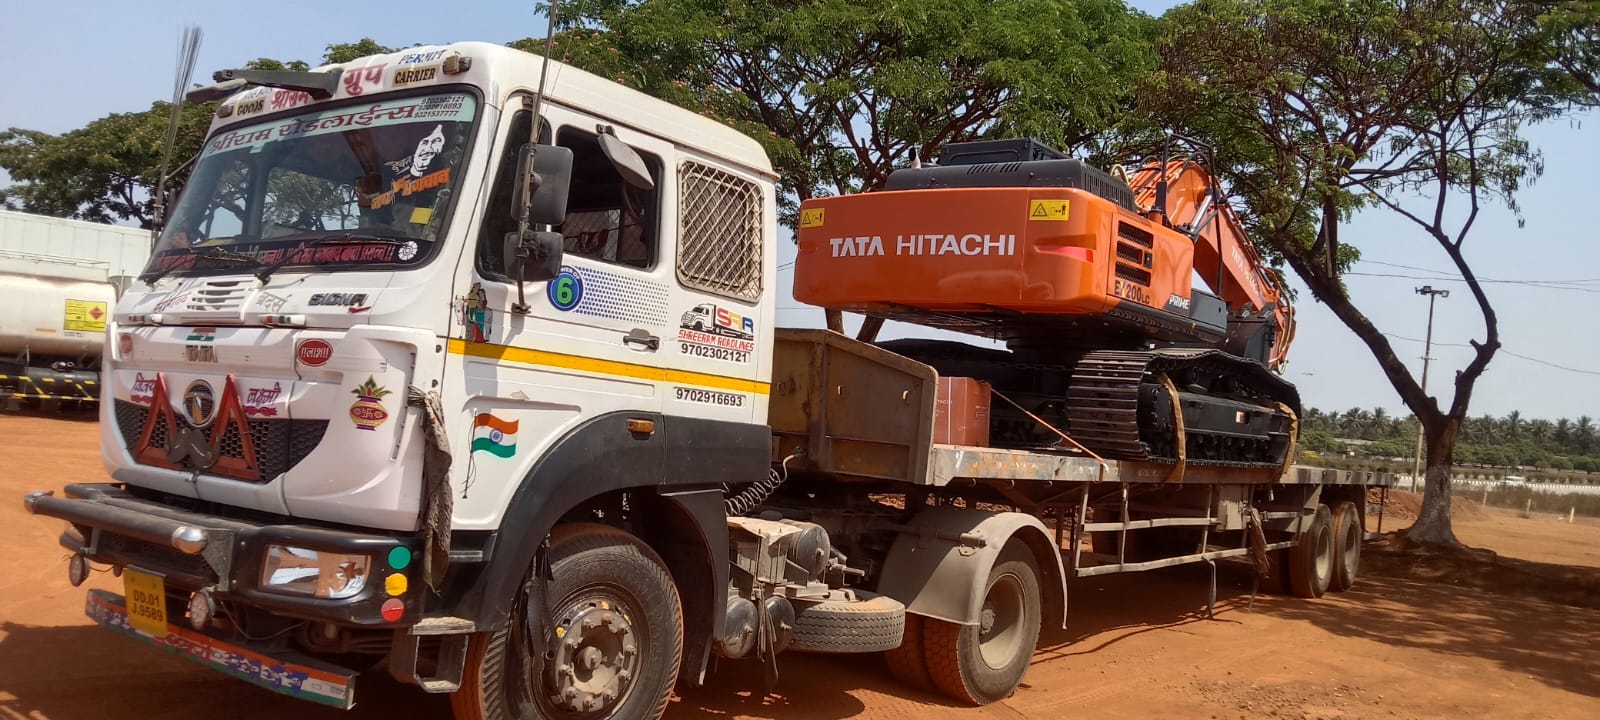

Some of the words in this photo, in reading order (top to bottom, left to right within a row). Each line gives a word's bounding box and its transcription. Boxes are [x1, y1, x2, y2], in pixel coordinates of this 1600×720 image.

[399, 50, 447, 64] PERMIT
[344, 63, 388, 96] ग्रुप
[237, 100, 265, 116] GOODS
[395, 68, 436, 84] CARRIER
[208, 128, 276, 153] श्रीराम
[830, 235, 884, 257] TATA
[896, 234, 1016, 256] HITACHI
[308, 293, 368, 306] SIGNA
[557, 278, 573, 304] 6
[1169, 294, 1190, 309] PRIME
[678, 330, 716, 346] SHREERAM
[717, 337, 755, 351] ROADLINES
[186, 344, 218, 363] TATA
[681, 343, 747, 363] 9702302121
[676, 388, 742, 407] 9702916693
[133, 590, 160, 608] DD.01
